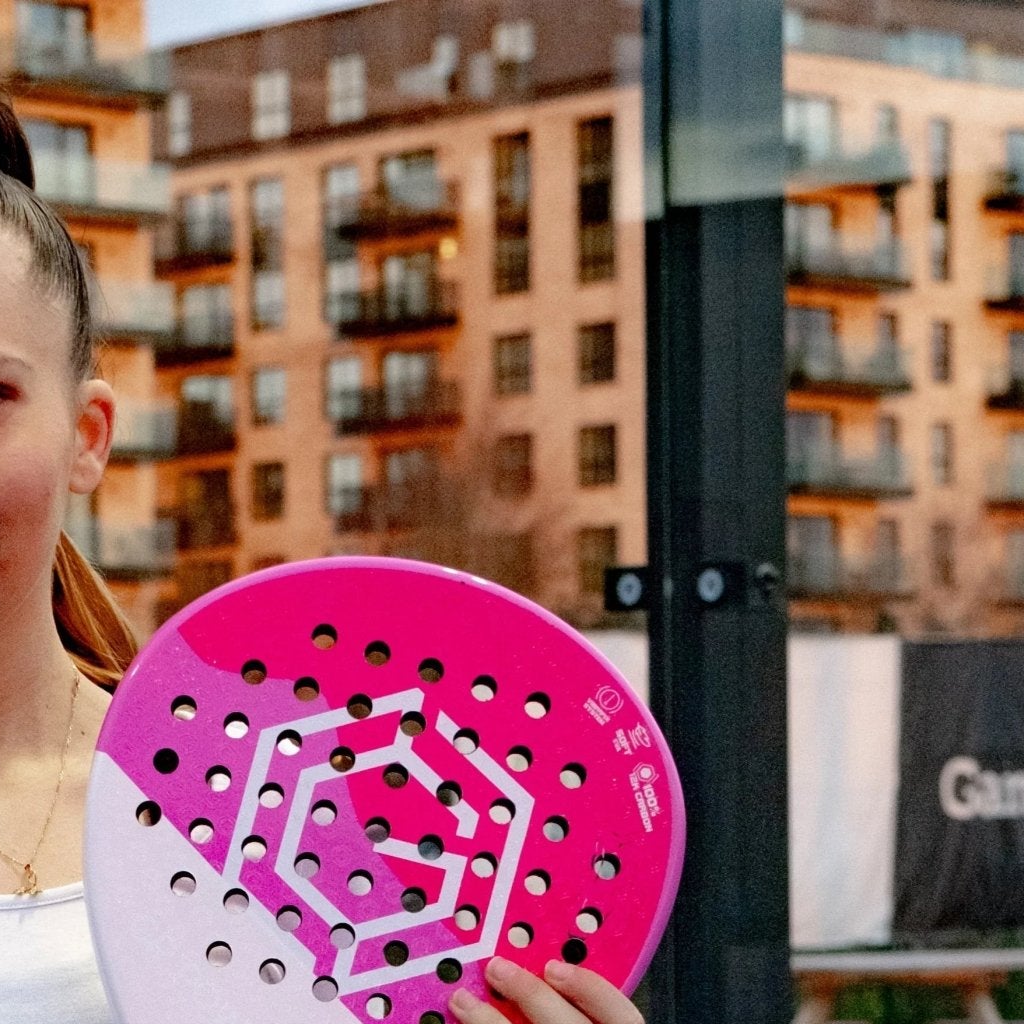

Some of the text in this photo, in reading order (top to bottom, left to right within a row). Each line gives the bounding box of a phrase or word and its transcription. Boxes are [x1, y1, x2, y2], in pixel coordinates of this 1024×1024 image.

[616, 729, 632, 755] SOFT
[635, 791, 653, 832] CARBON
[643, 784, 660, 817] 100%
